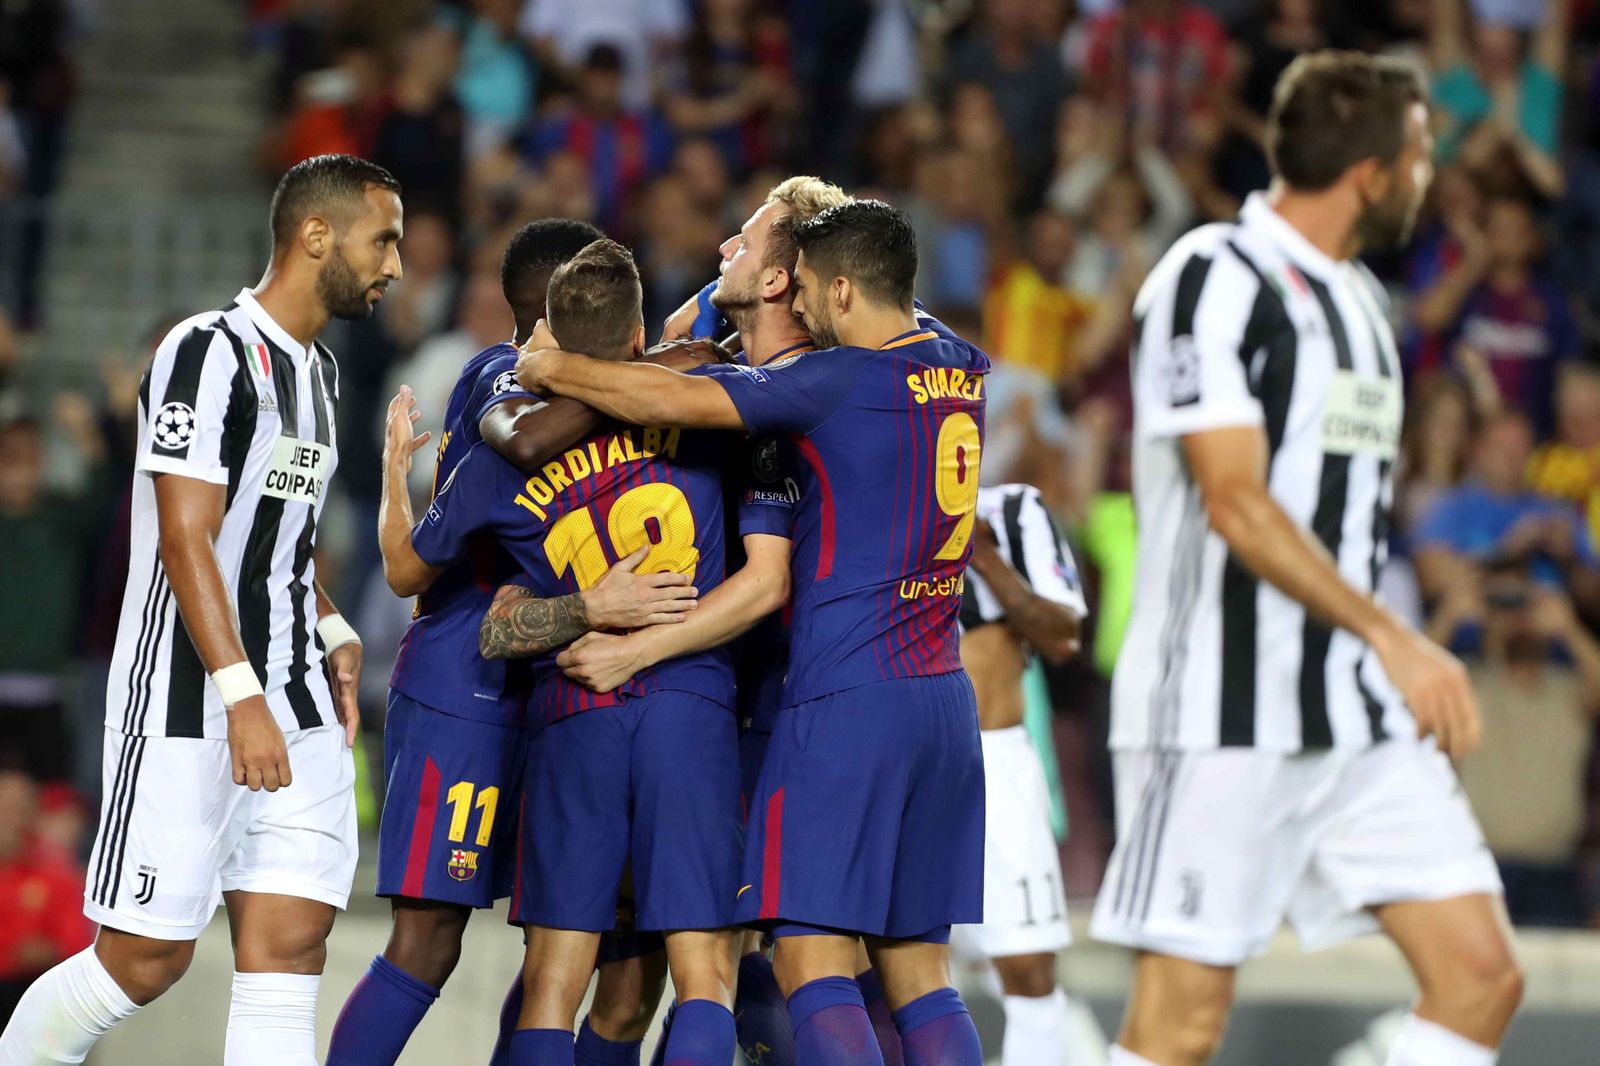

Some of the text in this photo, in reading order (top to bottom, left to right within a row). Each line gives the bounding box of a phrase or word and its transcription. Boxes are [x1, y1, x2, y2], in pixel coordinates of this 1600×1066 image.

[514, 442, 602, 522] JORDI
[607, 427, 681, 468] ALBA
[754, 490, 791, 504] RESPEC
[933, 412, 980, 560] 9
[543, 482, 700, 592] 18
[446, 781, 499, 847] 11
[1018, 872, 1060, 925] 11
